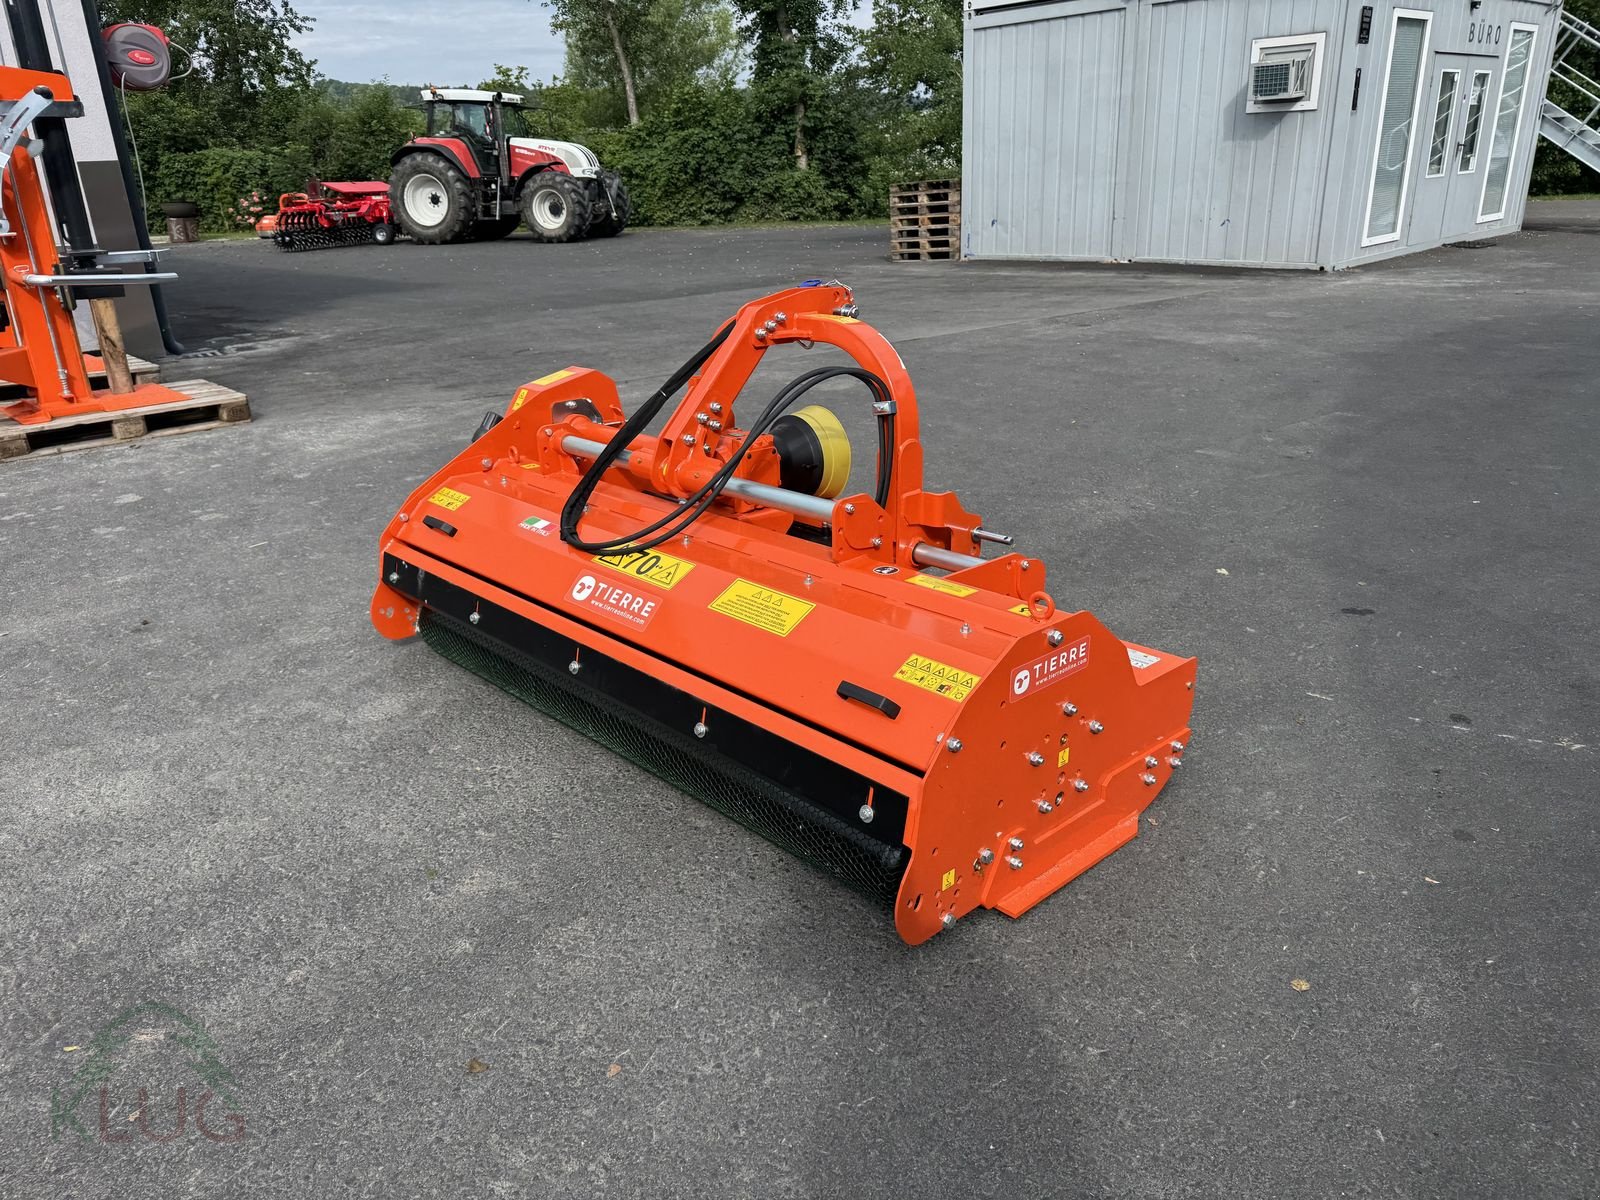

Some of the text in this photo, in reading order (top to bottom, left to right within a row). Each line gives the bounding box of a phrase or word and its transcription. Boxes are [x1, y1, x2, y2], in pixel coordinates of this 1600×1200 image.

[1468, 18, 1501, 45] BÜRO
[622, 549, 661, 575] 70
[590, 599, 645, 625] www.tierreonline.com
[594, 582, 655, 618] TIERRE
[1033, 642, 1087, 679] TIERRE
[1035, 657, 1088, 686] www.tierreonline.com
